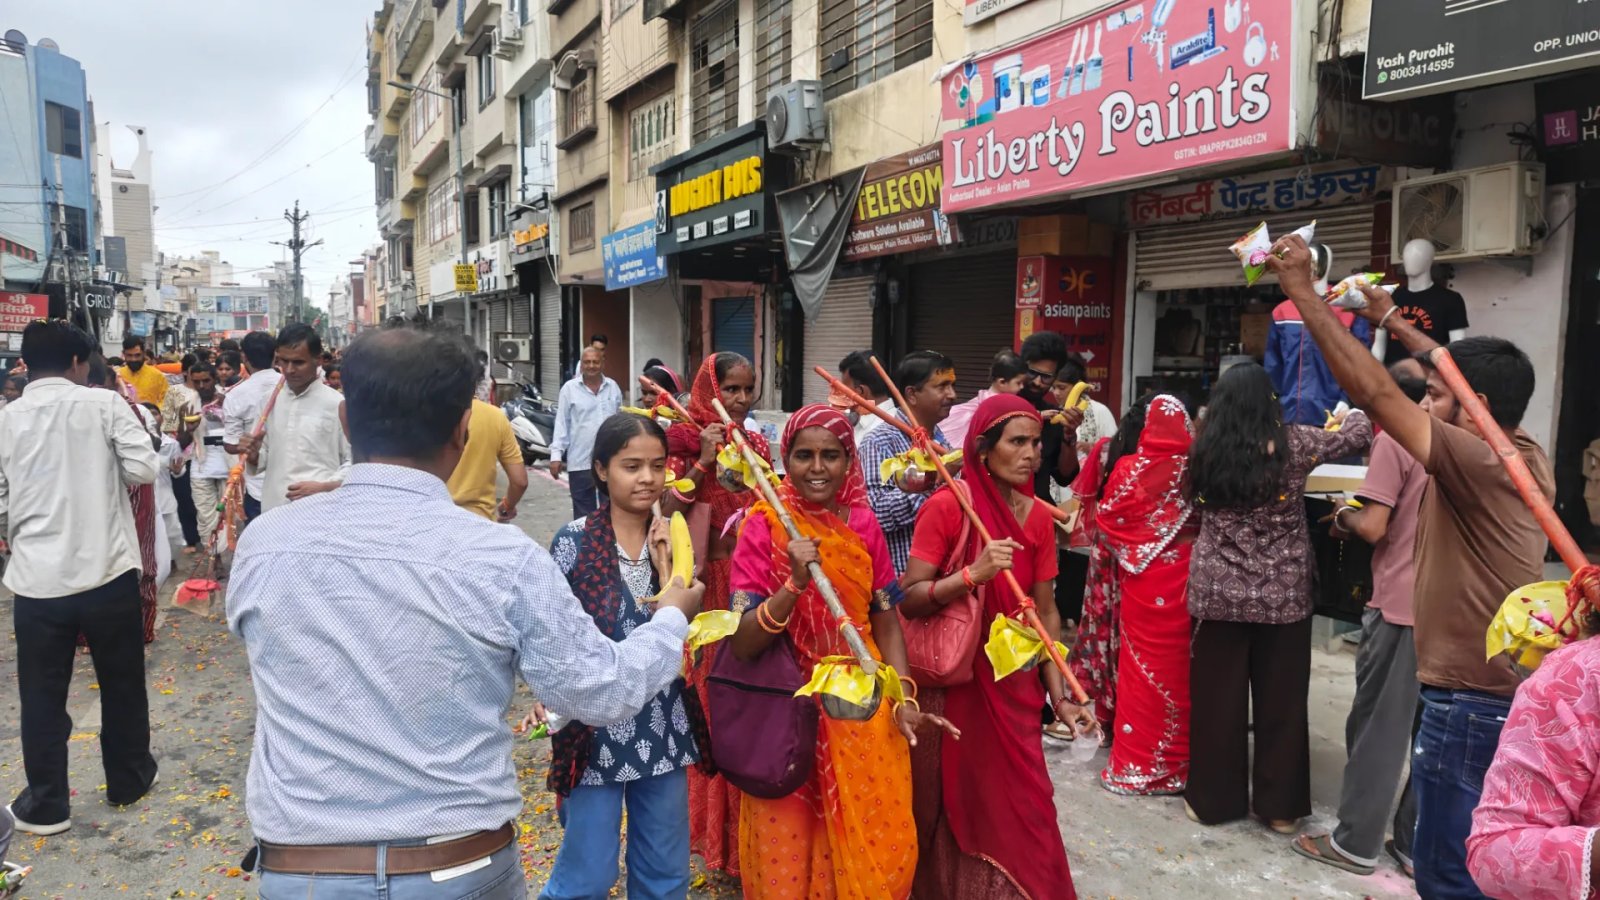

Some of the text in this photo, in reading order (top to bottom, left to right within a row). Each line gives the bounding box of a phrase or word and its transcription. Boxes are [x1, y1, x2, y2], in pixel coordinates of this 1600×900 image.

[975, 0, 1006, 15] LIBER
[1533, 30, 1600, 52] OPP. UNIO
[1377, 42, 1455, 70] Yash Purohit
[1389, 58, 1455, 81] 8003414595
[951, 66, 1271, 188] Liberty Paints
[857, 165, 944, 220] TELECOM
[1044, 301, 1111, 327] asianpaints
